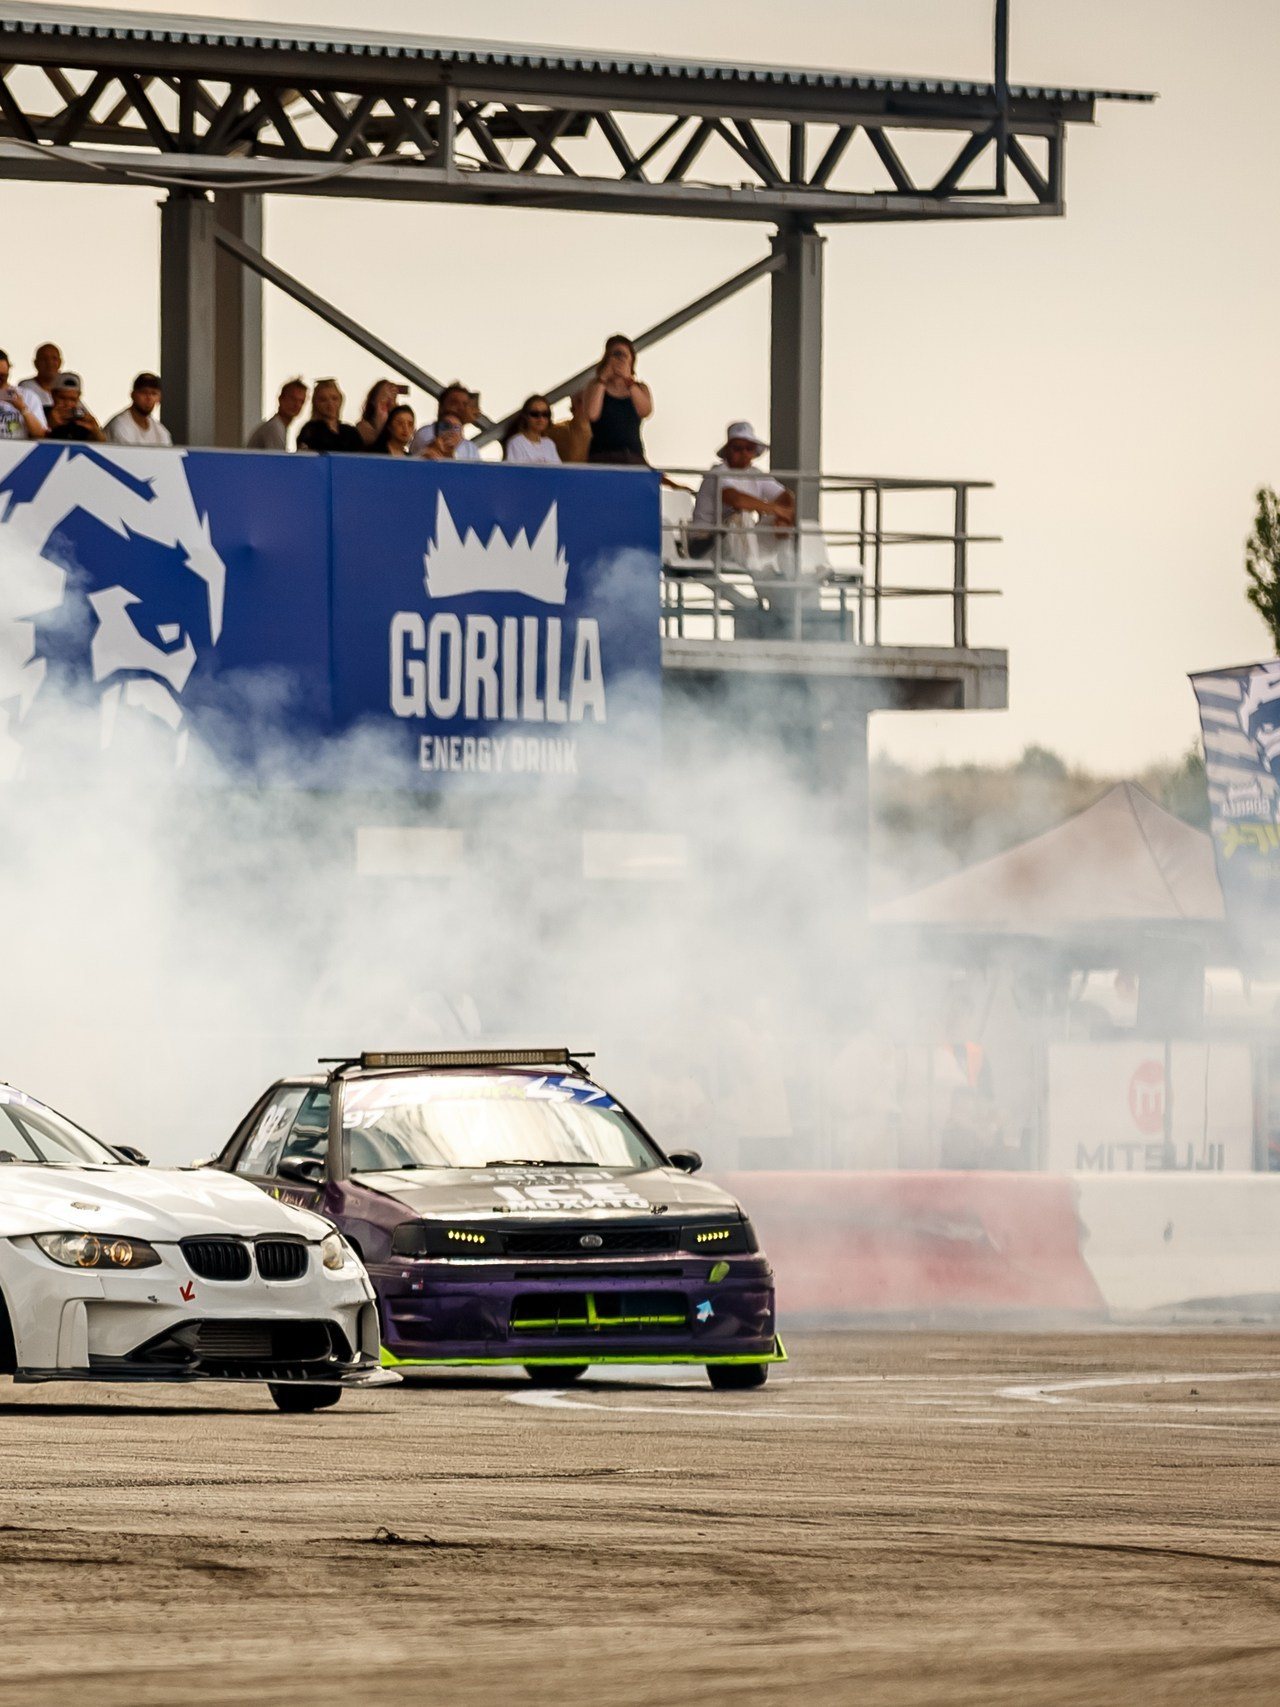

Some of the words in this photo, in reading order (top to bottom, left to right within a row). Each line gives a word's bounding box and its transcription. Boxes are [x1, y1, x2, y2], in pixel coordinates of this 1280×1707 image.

[389, 612, 607, 724] GORILLA
[421, 735, 505, 773] ENERGY
[510, 737, 578, 775] DRINK
[343, 1110, 385, 1129] 97
[493, 1183, 641, 1201] ICE
